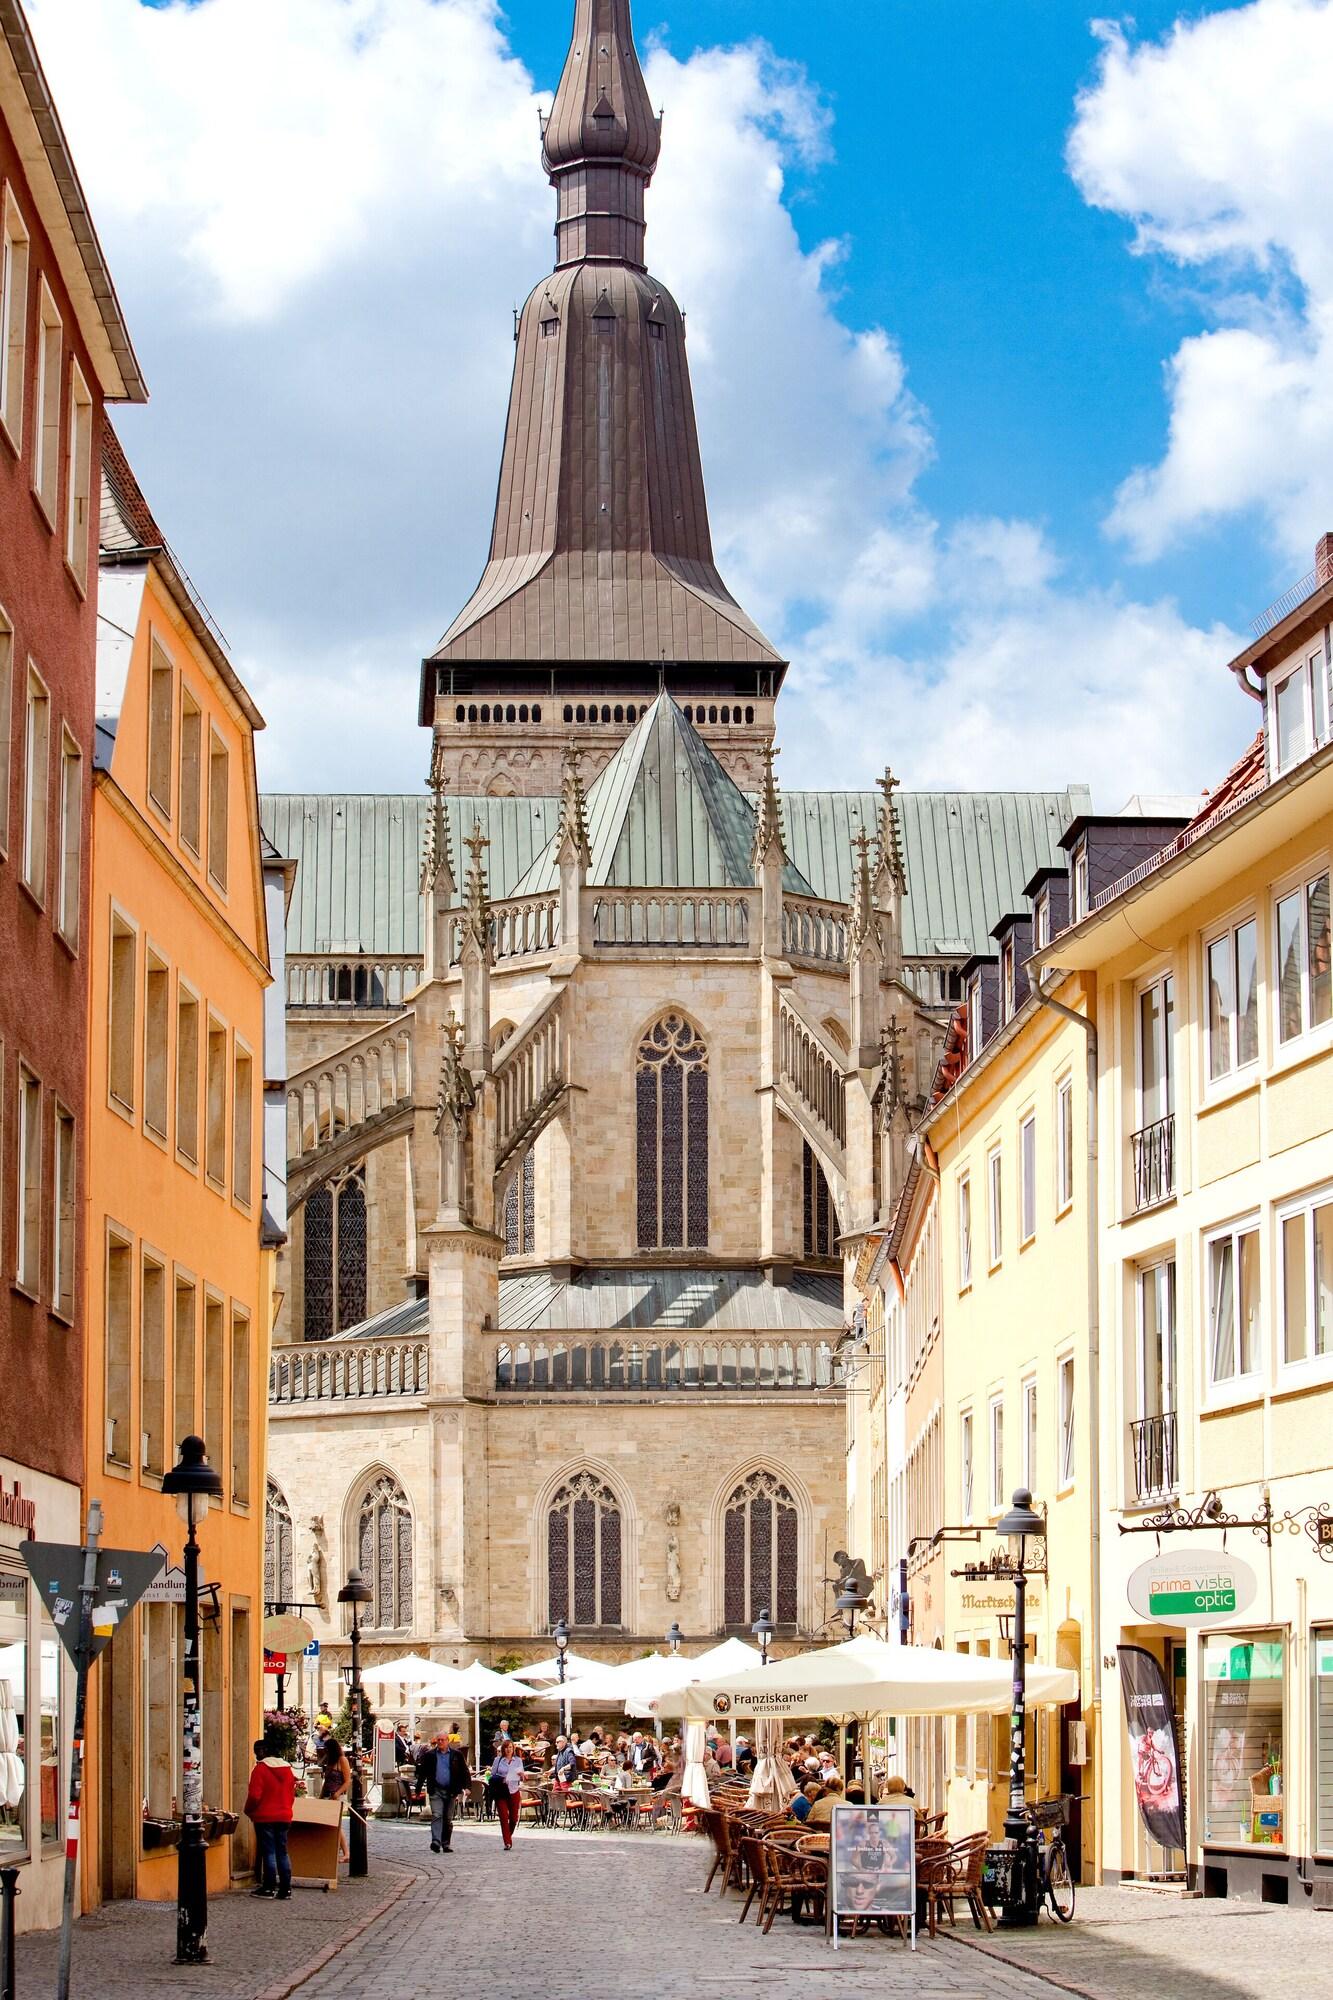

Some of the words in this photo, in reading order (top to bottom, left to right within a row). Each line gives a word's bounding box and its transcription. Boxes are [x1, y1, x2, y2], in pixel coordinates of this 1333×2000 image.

[1152, 1577, 1190, 1597] prima
[1195, 1574, 1232, 1590] vista
[962, 1594, 1040, 1610] Marktschke
[1194, 1590, 1233, 1612] optic
[306, 1642, 315, 1655] P
[734, 1692, 809, 1705] Franziskaner
